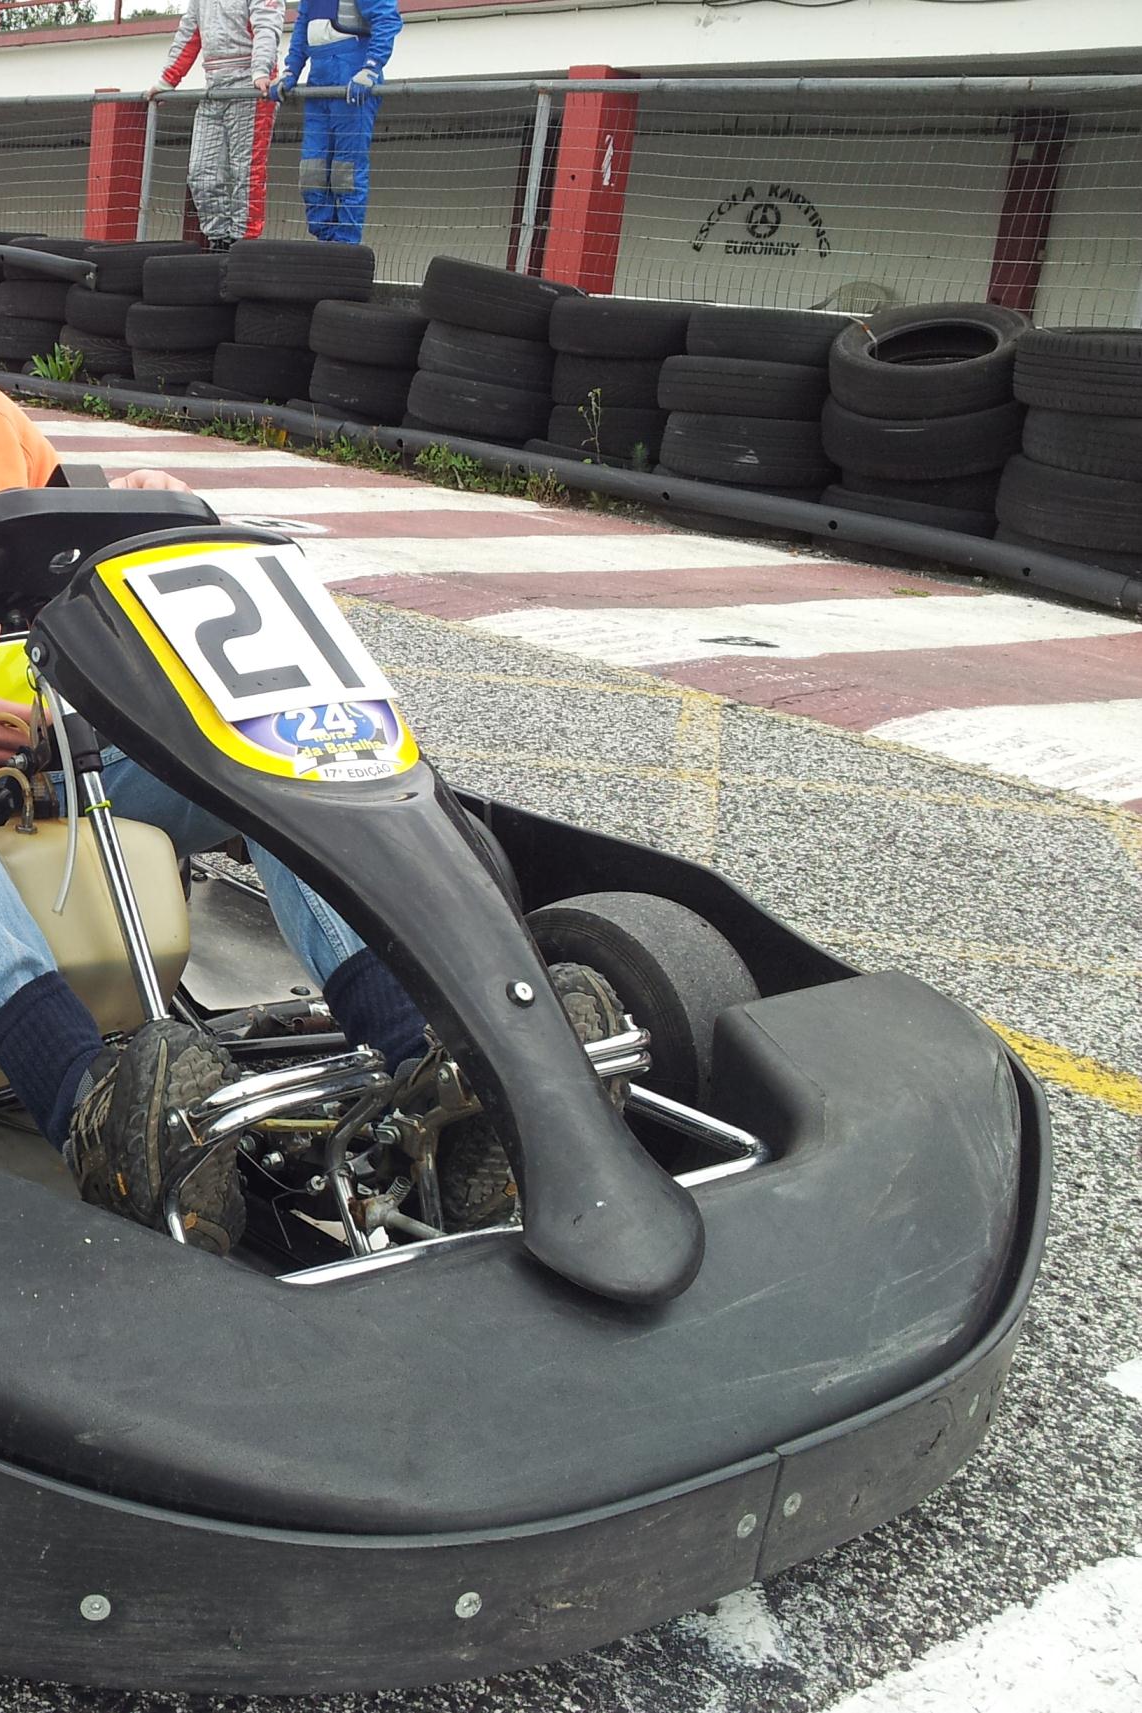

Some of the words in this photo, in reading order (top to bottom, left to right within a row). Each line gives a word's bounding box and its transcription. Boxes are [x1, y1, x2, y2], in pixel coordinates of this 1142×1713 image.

[692, 186, 755, 252] ESCOLA
[767, 183, 831, 258] KARTING
[724, 240, 800, 256] EUROINDY
[148, 555, 366, 699] 21
[284, 702, 357, 742] 24
[301, 746, 324, 759] da
[324, 739, 385, 755] Batalha
